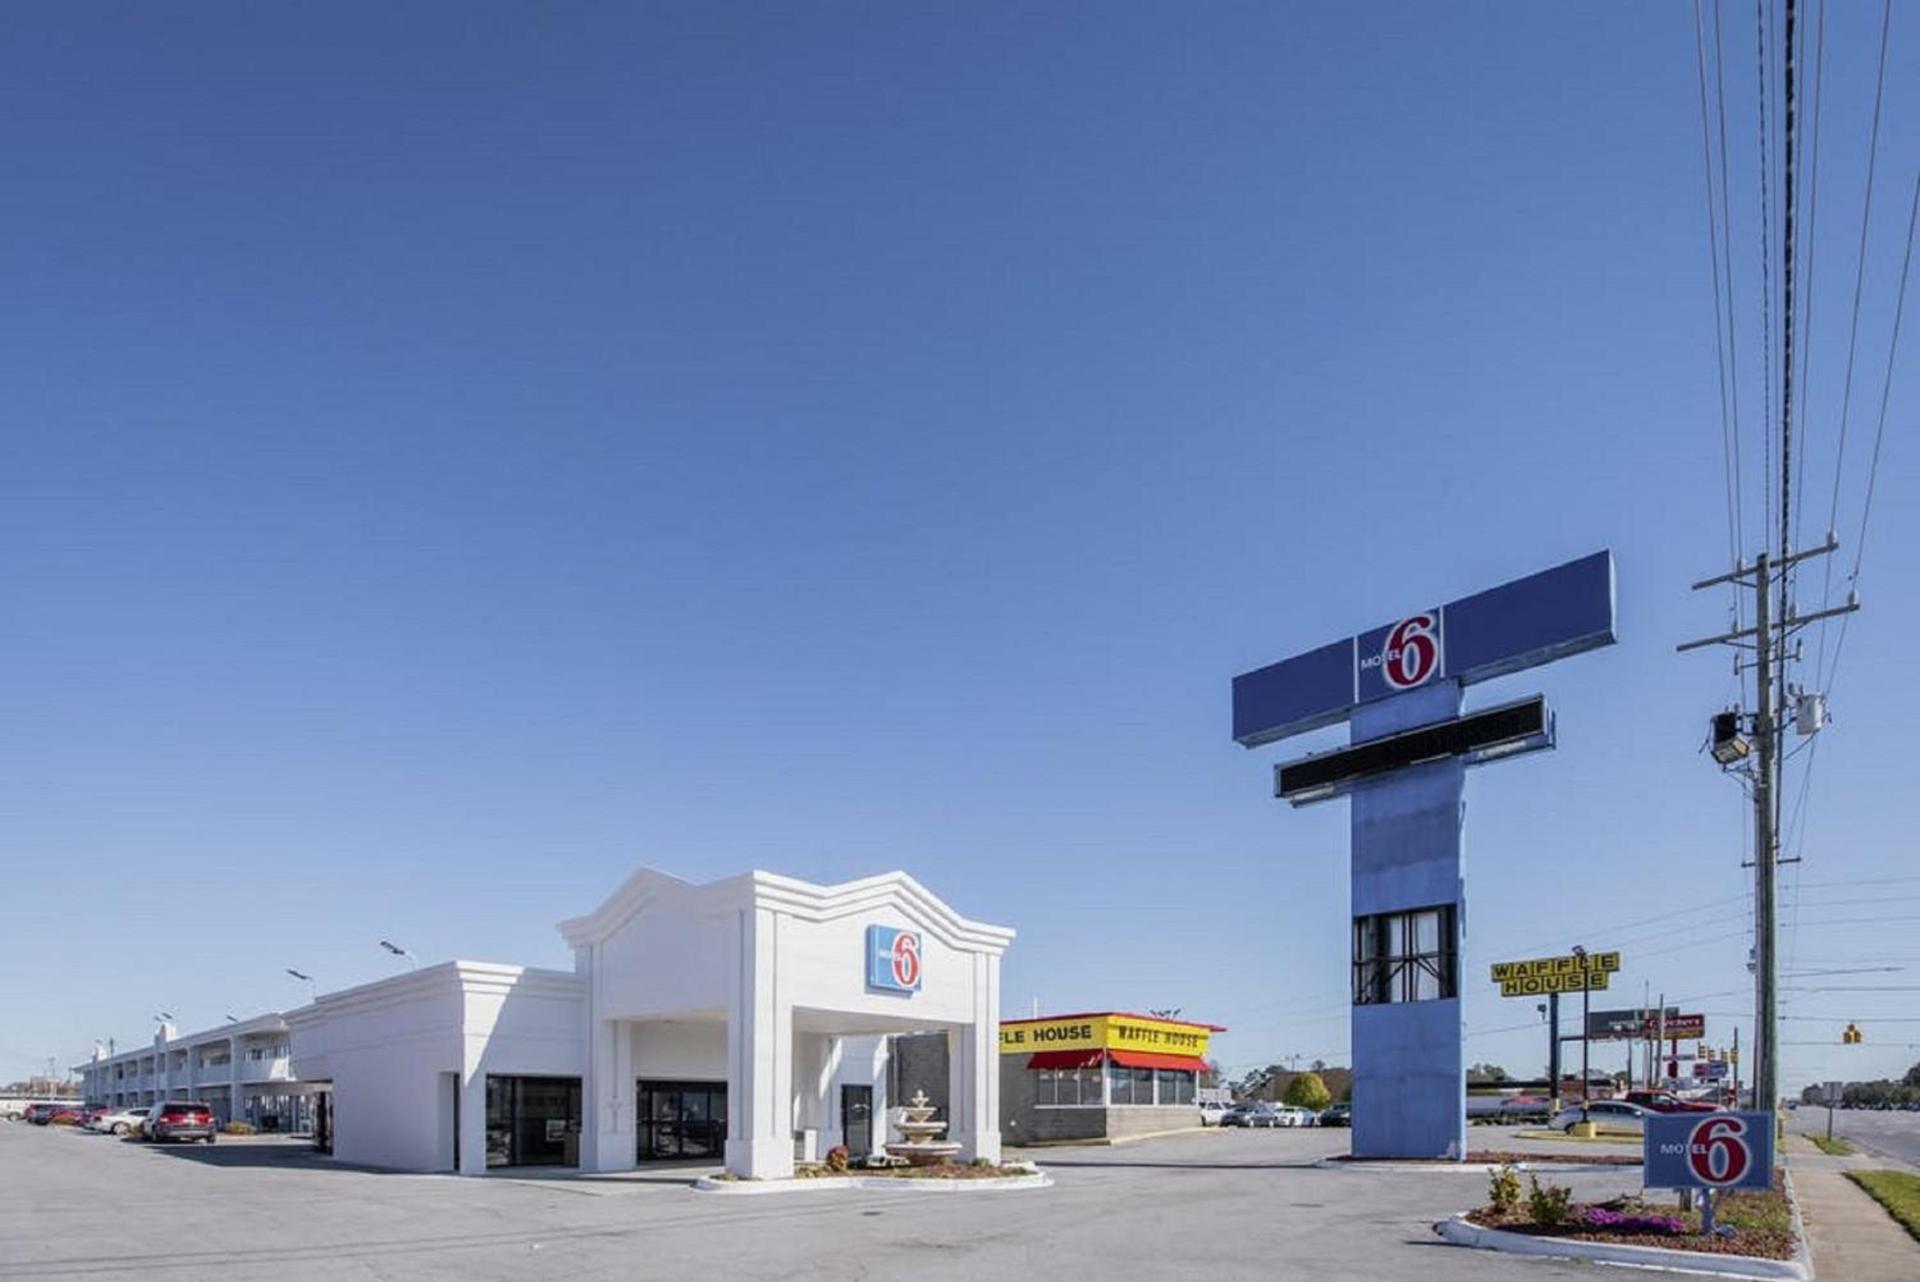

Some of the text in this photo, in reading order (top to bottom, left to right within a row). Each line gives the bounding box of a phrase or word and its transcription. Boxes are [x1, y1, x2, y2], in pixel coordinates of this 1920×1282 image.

[1383, 614, 1438, 689] 6
[892, 931, 920, 987] 6
[1494, 955, 1615, 977] WAFFLE
[1505, 974, 1604, 993] HOUSE
[1033, 1025, 1092, 1042] HOUSE
[1118, 1025, 1198, 1048] WAFFLE HOUSE
[1688, 1116, 1750, 1186] 6
